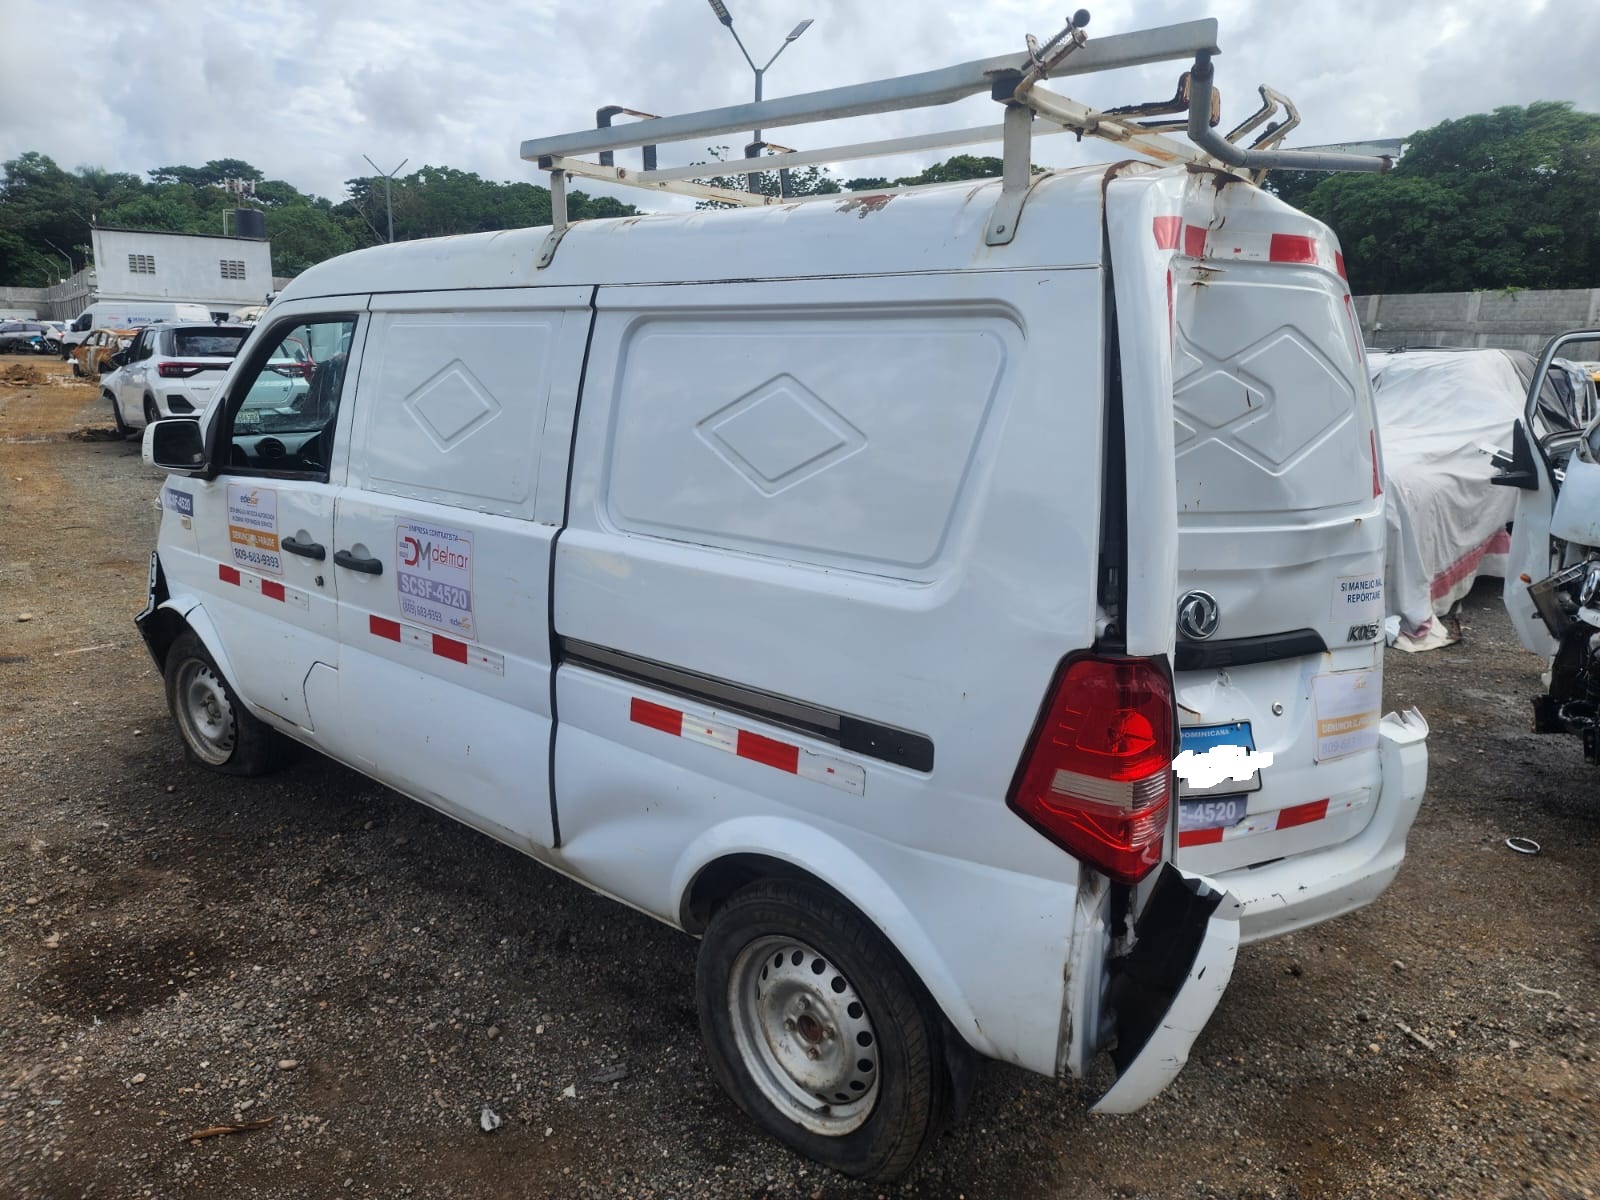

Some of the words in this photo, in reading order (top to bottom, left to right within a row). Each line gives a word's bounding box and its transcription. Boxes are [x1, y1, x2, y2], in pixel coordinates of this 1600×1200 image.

[165, 491, 191, 512] SF-4520
[431, 544, 468, 568] delmar
[401, 574, 467, 609] SCSF-4520
